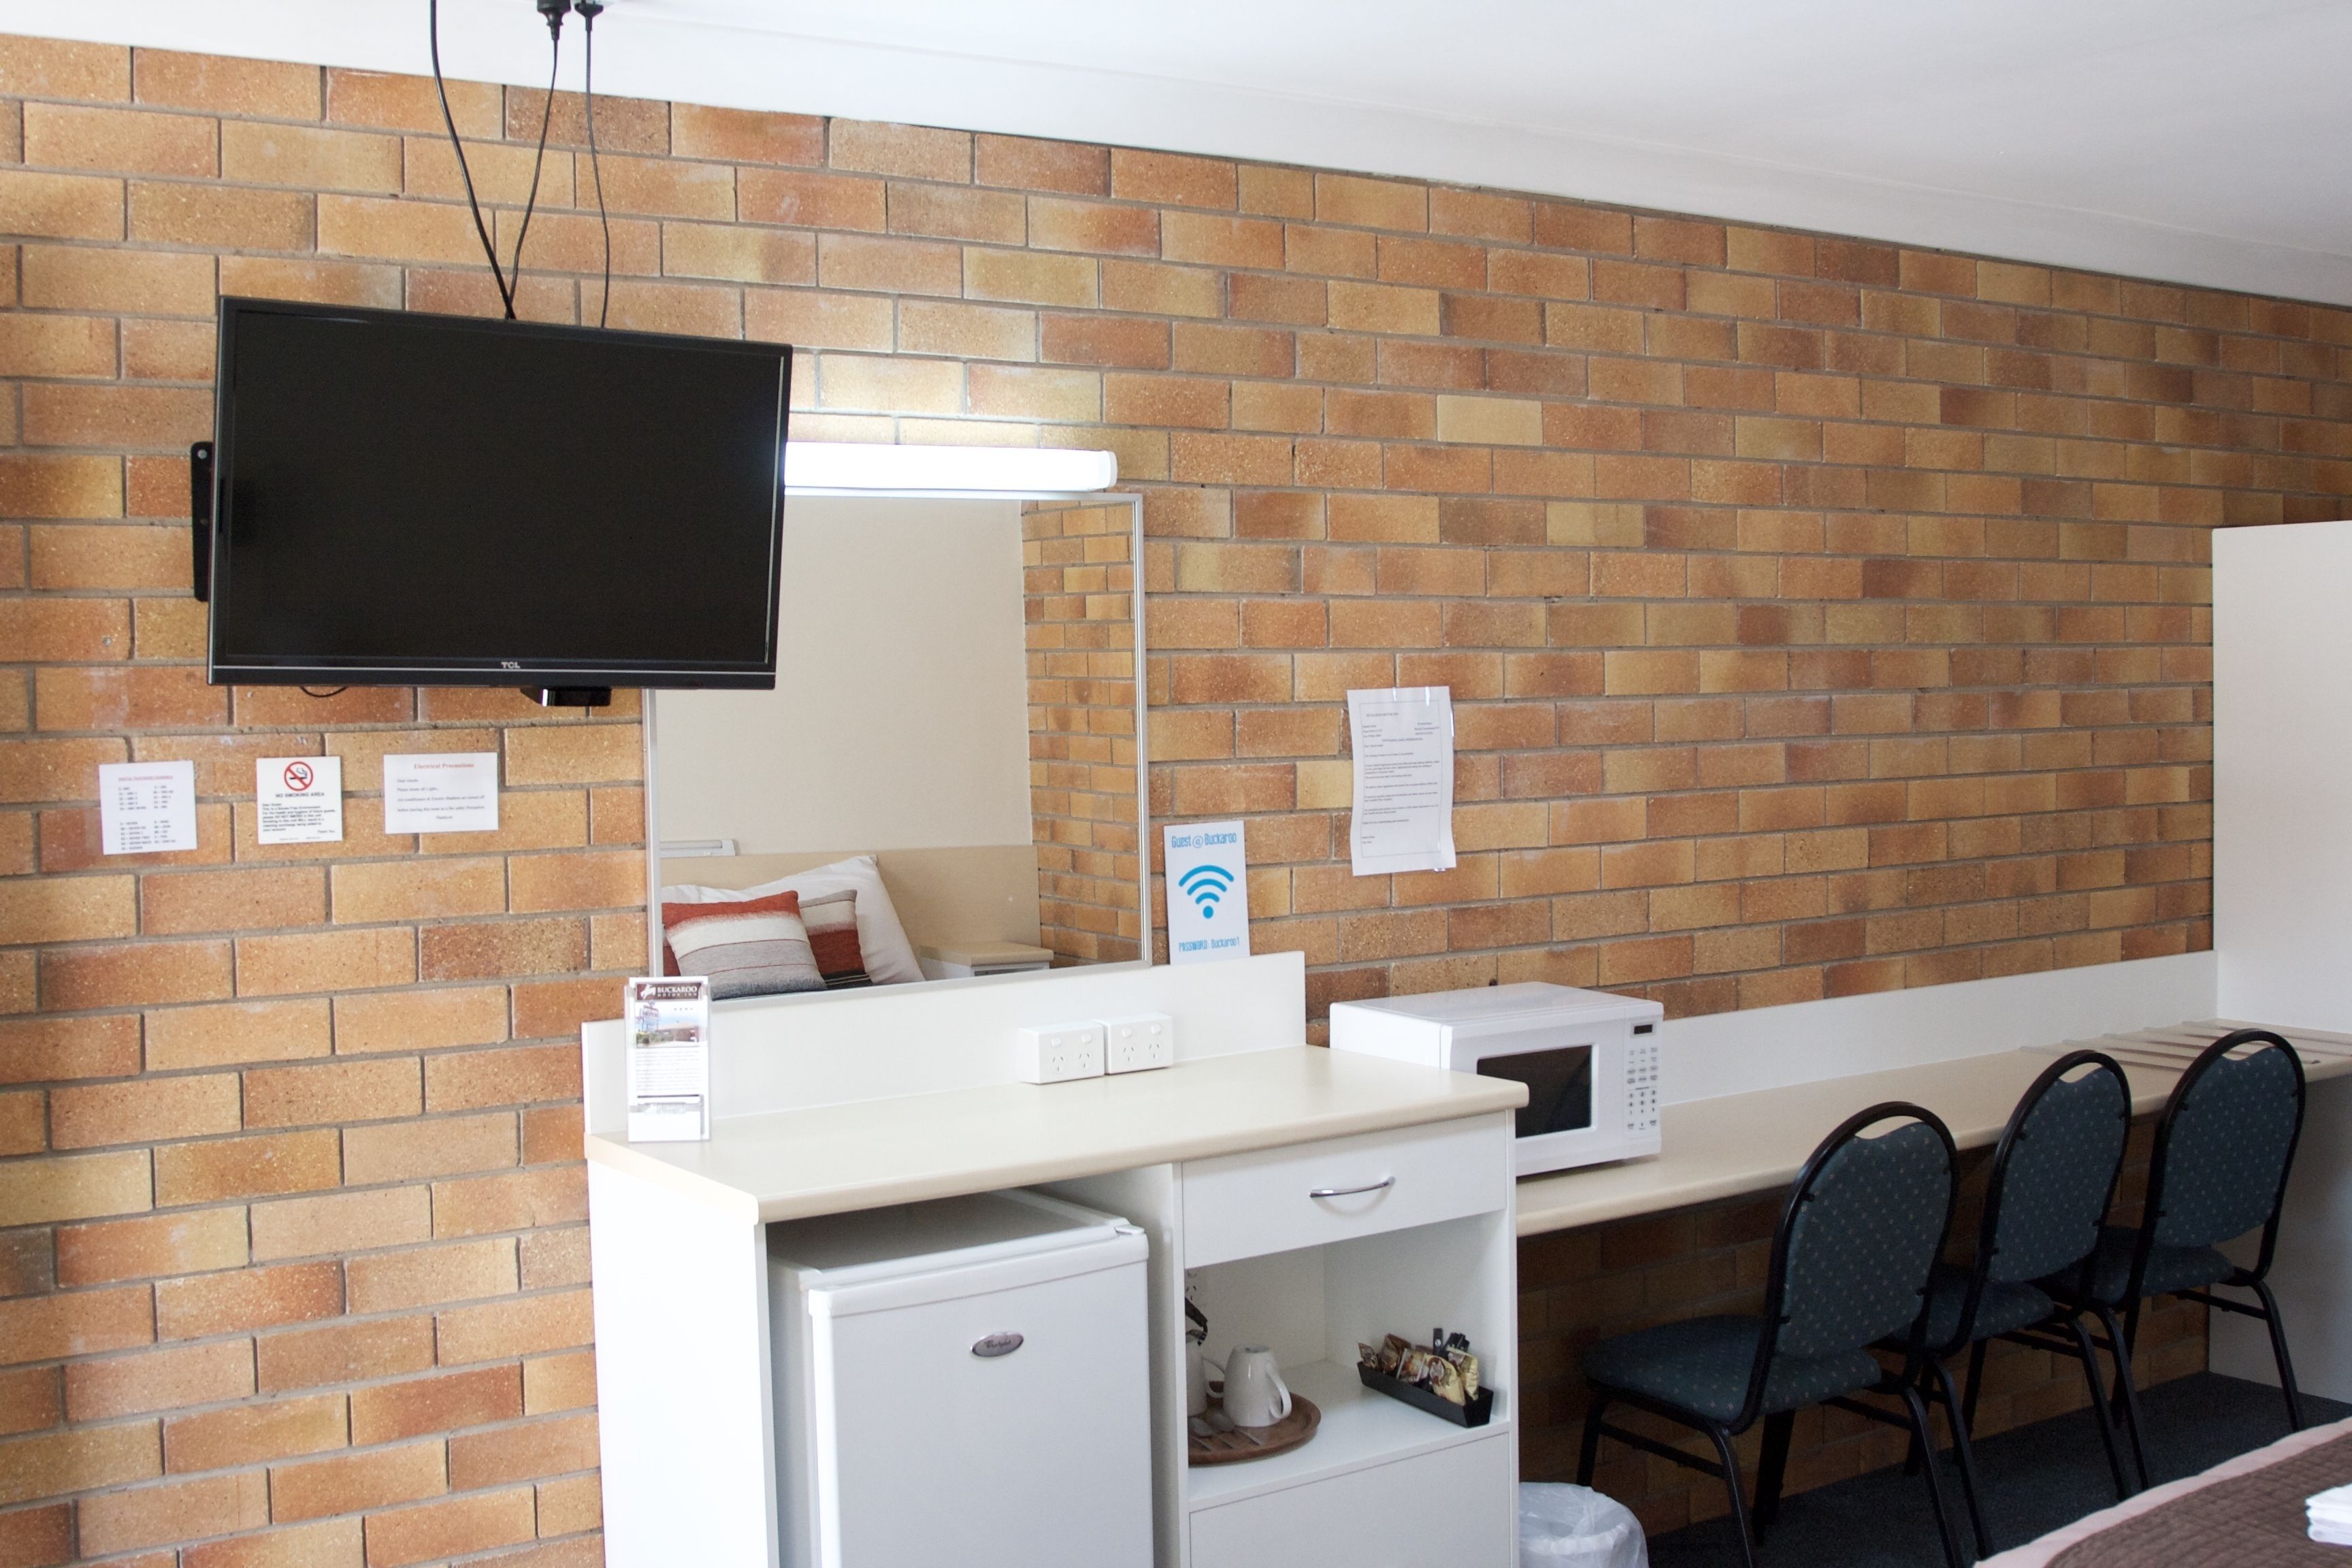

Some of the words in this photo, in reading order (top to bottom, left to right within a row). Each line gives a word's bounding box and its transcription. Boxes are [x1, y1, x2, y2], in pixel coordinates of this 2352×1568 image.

[1172, 835, 1191, 848] Guest
[1192, 836, 1203, 848] @
[1204, 832, 1237, 845] Buckaroo
